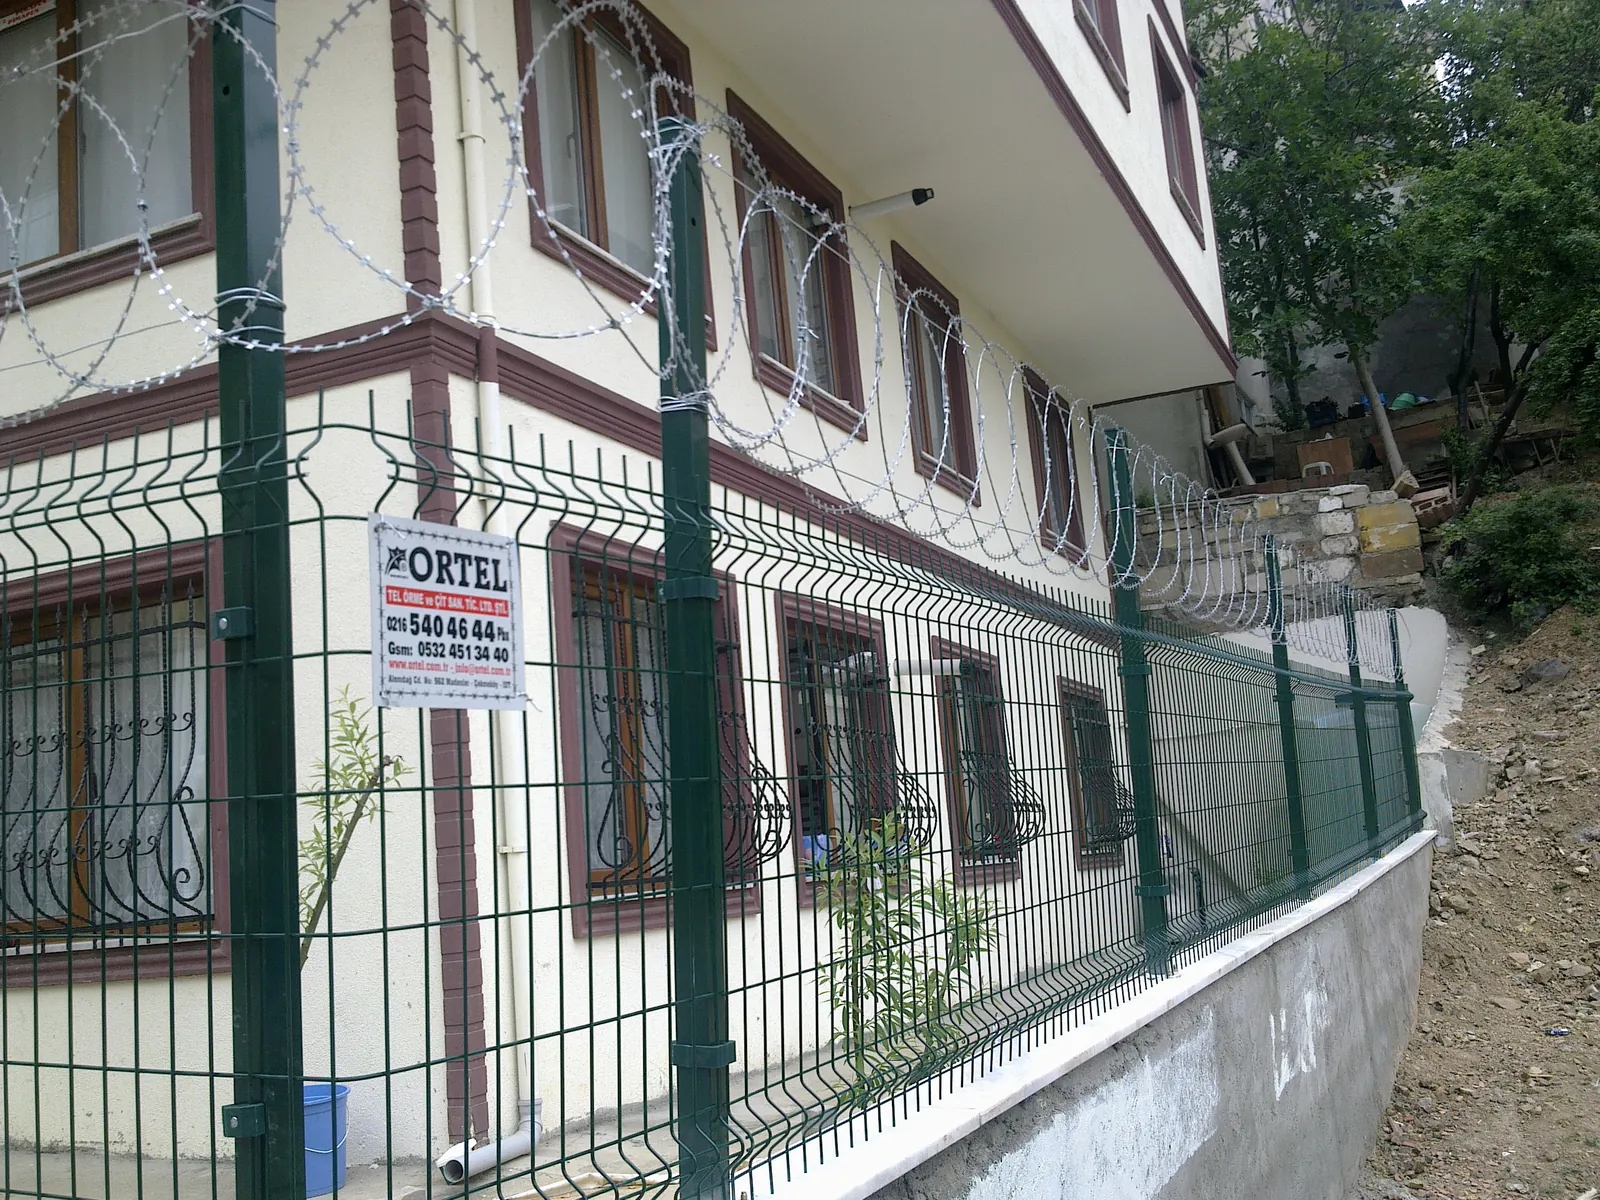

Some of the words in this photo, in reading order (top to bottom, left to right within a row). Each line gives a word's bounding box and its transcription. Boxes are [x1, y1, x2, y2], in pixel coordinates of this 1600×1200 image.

[409, 546, 508, 593] ORTEL
[387, 589, 402, 602] TEL
[387, 616, 407, 632] 0216
[410, 612, 443, 638] 540
[447, 617, 468, 640] 46
[472, 619, 495, 642] 44
[388, 641, 413, 656] Gsm:
[418, 641, 446, 658] 0532
[449, 643, 471, 660] 451
[474, 645, 490, 661] 34
[493, 647, 509, 662] 40
